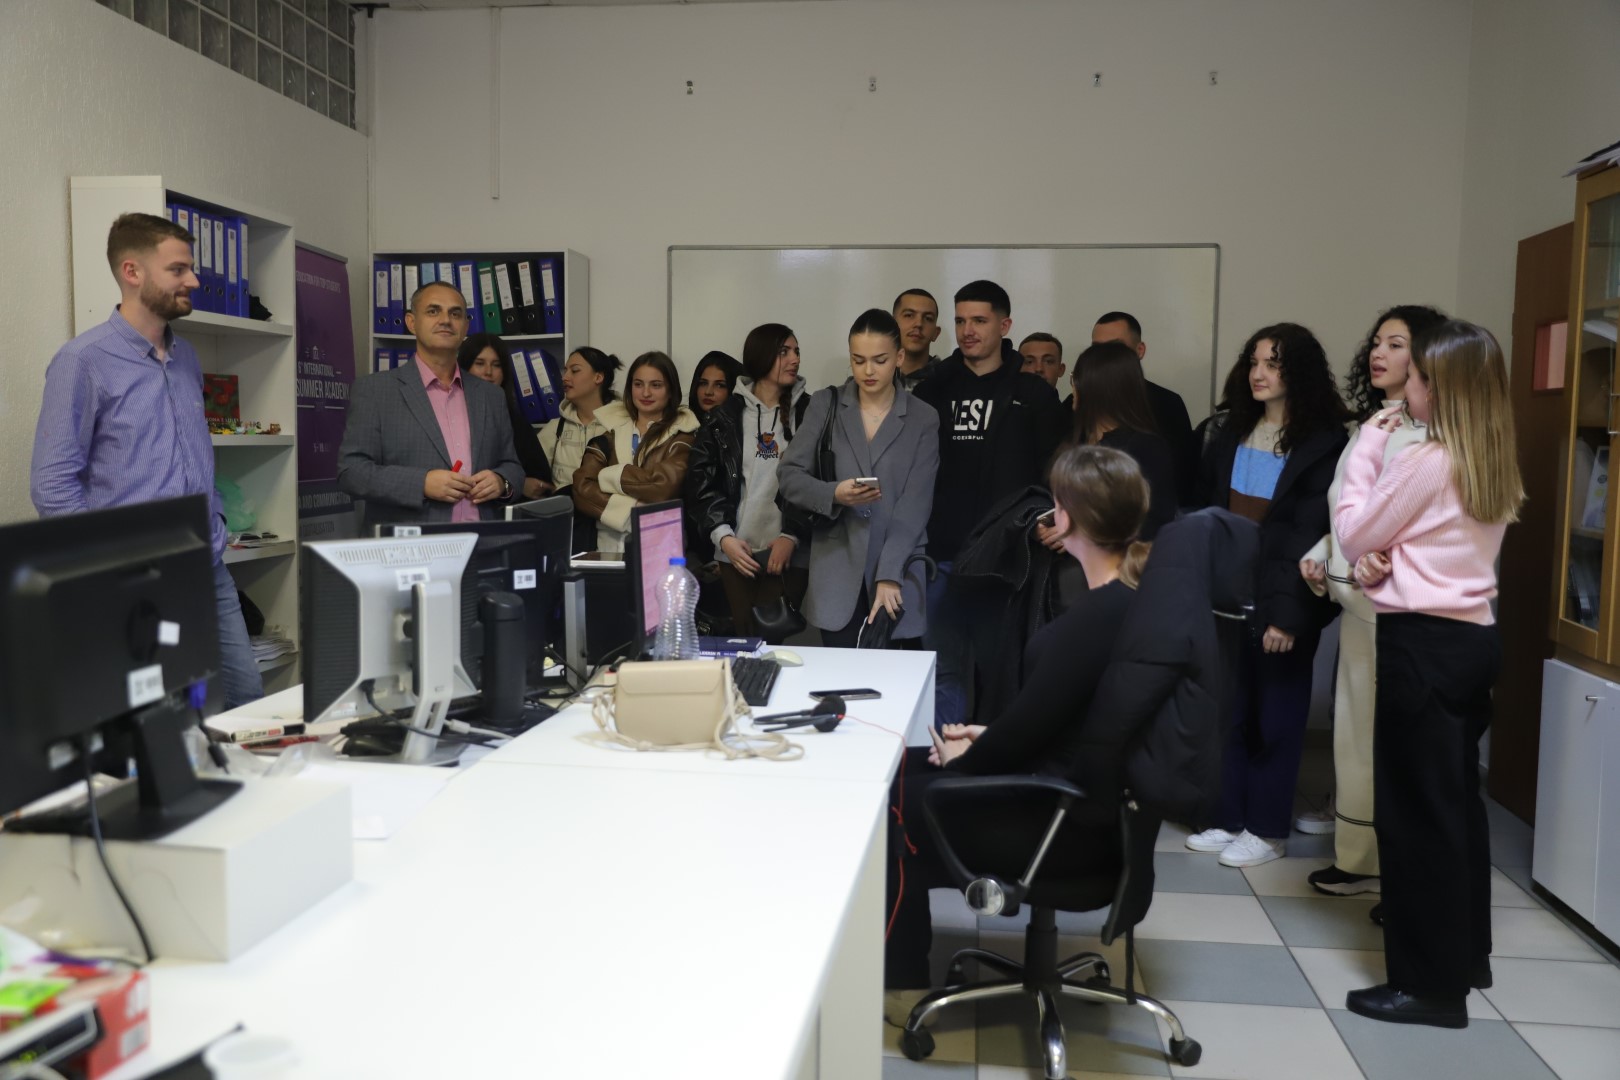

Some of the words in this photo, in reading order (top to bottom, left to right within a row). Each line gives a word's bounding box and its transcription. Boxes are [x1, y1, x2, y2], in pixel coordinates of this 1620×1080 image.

[303, 362, 334, 377] INTERNATIONAL
[296, 378, 323, 399] SUMMER
[324, 380, 350, 400] ACADEMY
